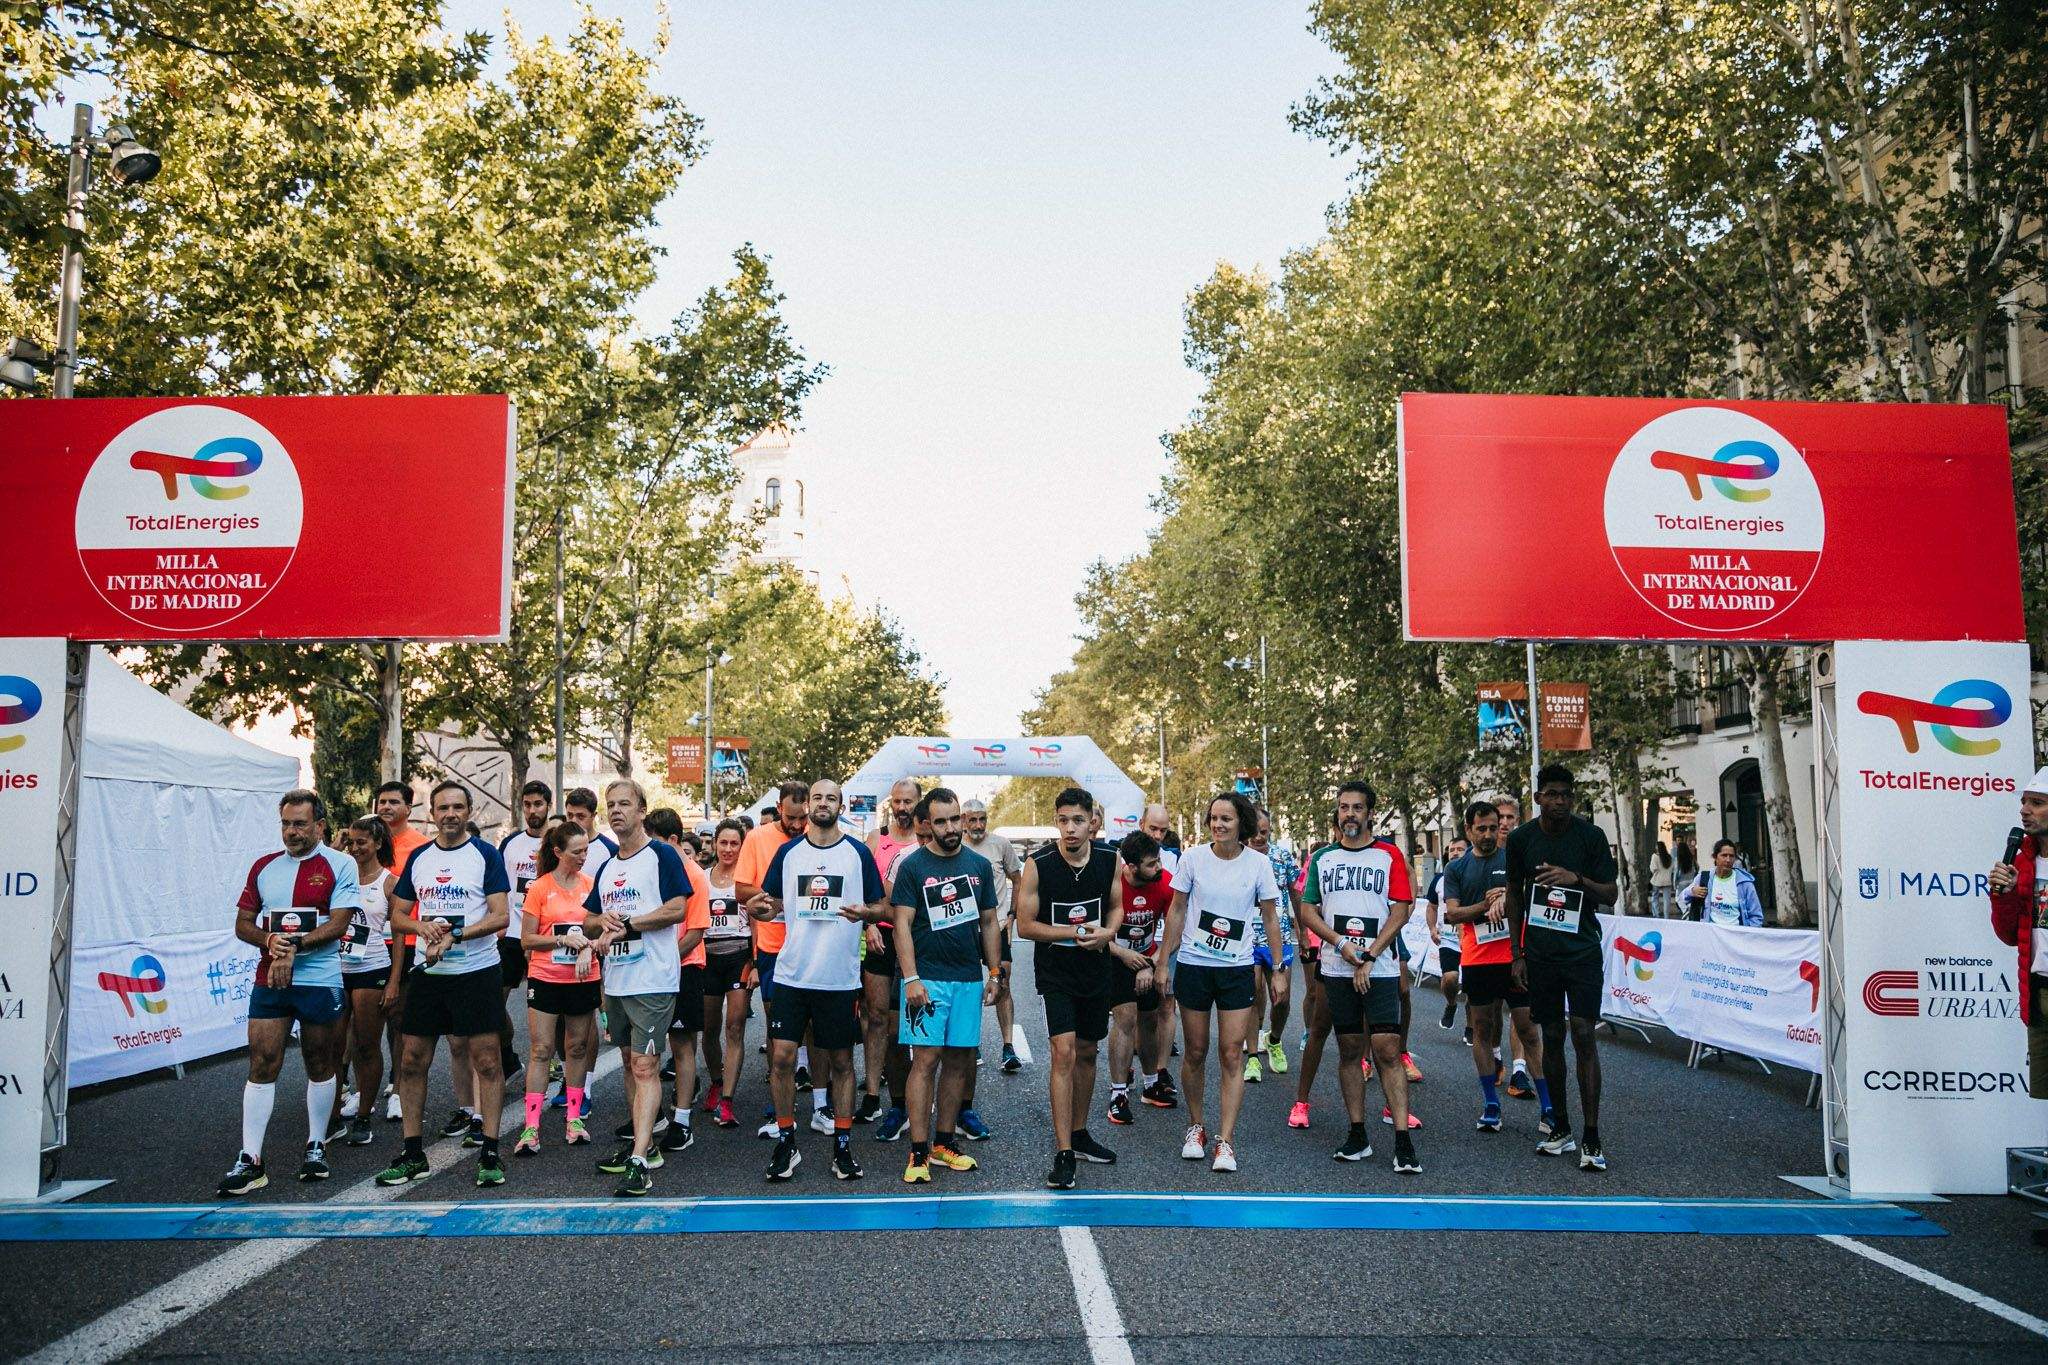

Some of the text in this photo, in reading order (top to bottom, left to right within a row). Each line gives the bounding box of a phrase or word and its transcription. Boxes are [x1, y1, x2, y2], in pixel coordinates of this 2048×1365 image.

[126, 513, 260, 534] TotalEnergies
[1654, 514, 1785, 536] TotalEnergies
[156, 554, 219, 570] MILLA
[1689, 554, 1751, 571] MILLA
[130, 593, 242, 610] DE MADRID
[1667, 594, 1775, 611] DE MADRID
[1480, 690, 1502, 699] ISLA
[1546, 694, 1585, 705] FERNÁN
[1859, 770, 2016, 797] TotalEnergies
[1322, 863, 1385, 895] MÉXICO
[810, 896, 829, 911] 778
[941, 900, 964, 919] 783
[710, 915, 728, 927] 780
[1543, 907, 1566, 922] 478
[1205, 934, 1229, 951] 467
[1925, 956, 1993, 967] new balance
[1926, 970, 2012, 993] MILLA
[113, 1024, 183, 1051] TotalEnergies
